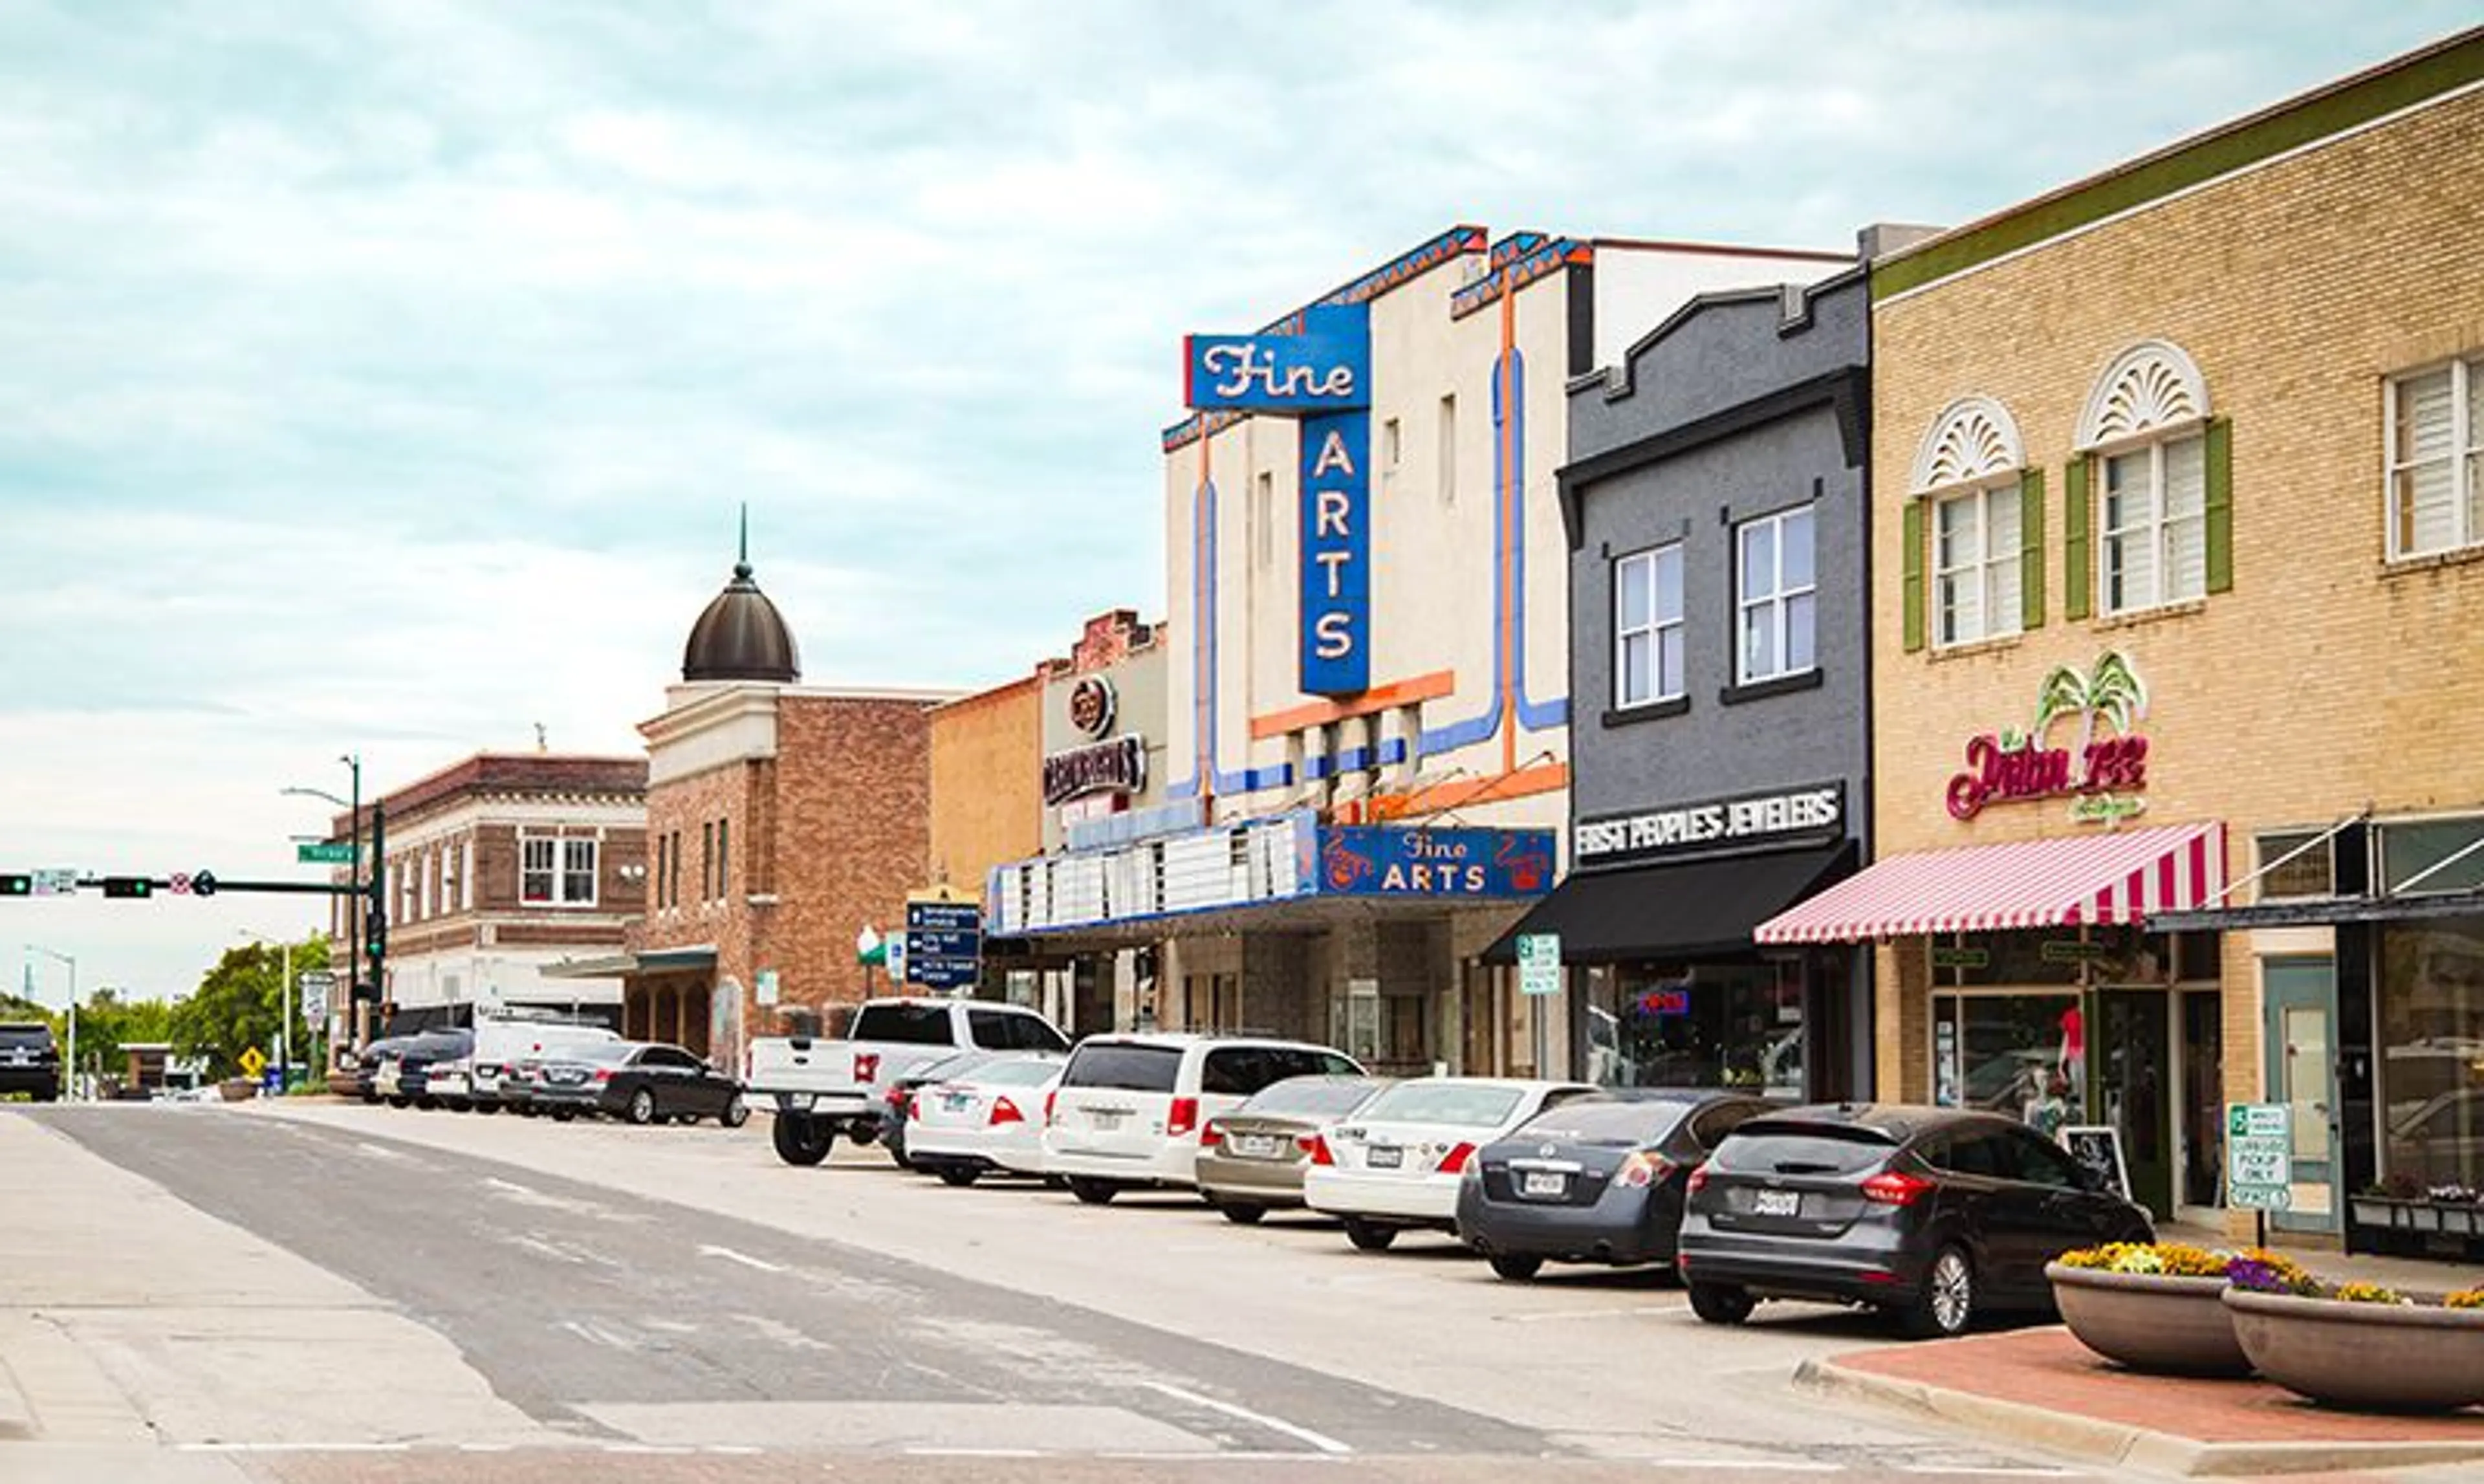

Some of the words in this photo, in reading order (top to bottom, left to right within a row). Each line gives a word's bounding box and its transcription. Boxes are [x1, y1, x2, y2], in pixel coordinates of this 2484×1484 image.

[1203, 343, 1355, 398] Fine
[1312, 429, 1355, 660] ARTS
[1402, 831, 1468, 859] Fine
[1576, 818, 1628, 855] FIRST
[1727, 789, 1838, 836] JEWELERS
[1381, 863, 1485, 891] ARTS
